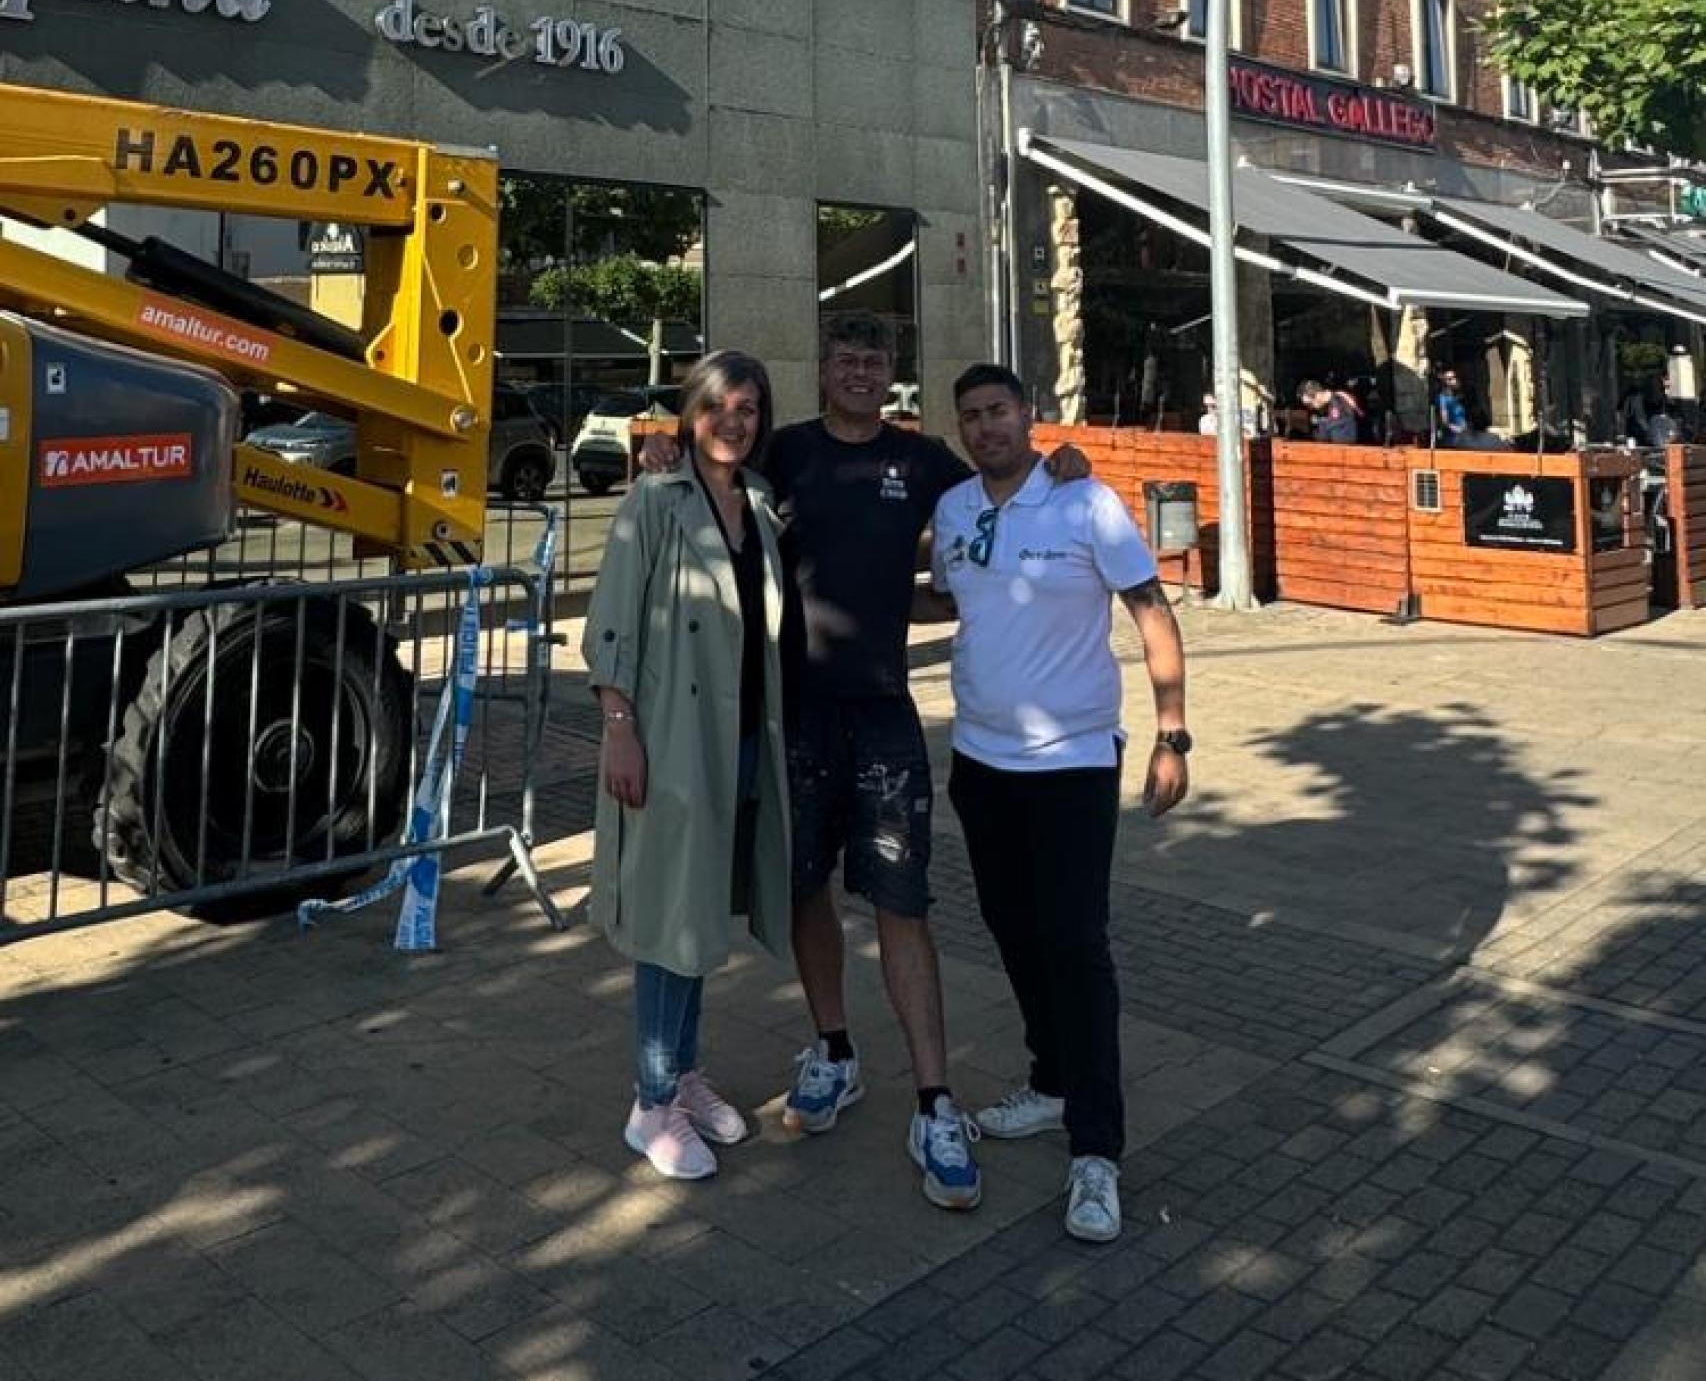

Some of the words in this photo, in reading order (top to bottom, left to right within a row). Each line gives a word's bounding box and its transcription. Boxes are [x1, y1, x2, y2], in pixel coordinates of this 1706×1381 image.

[529, 17, 624, 73] 1916
[1328, 93, 1434, 142] GALLEGO
[115, 128, 397, 198] HA260PX
[141, 306, 269, 361] amaltur.com
[71, 445, 185, 472] AMALTUR
